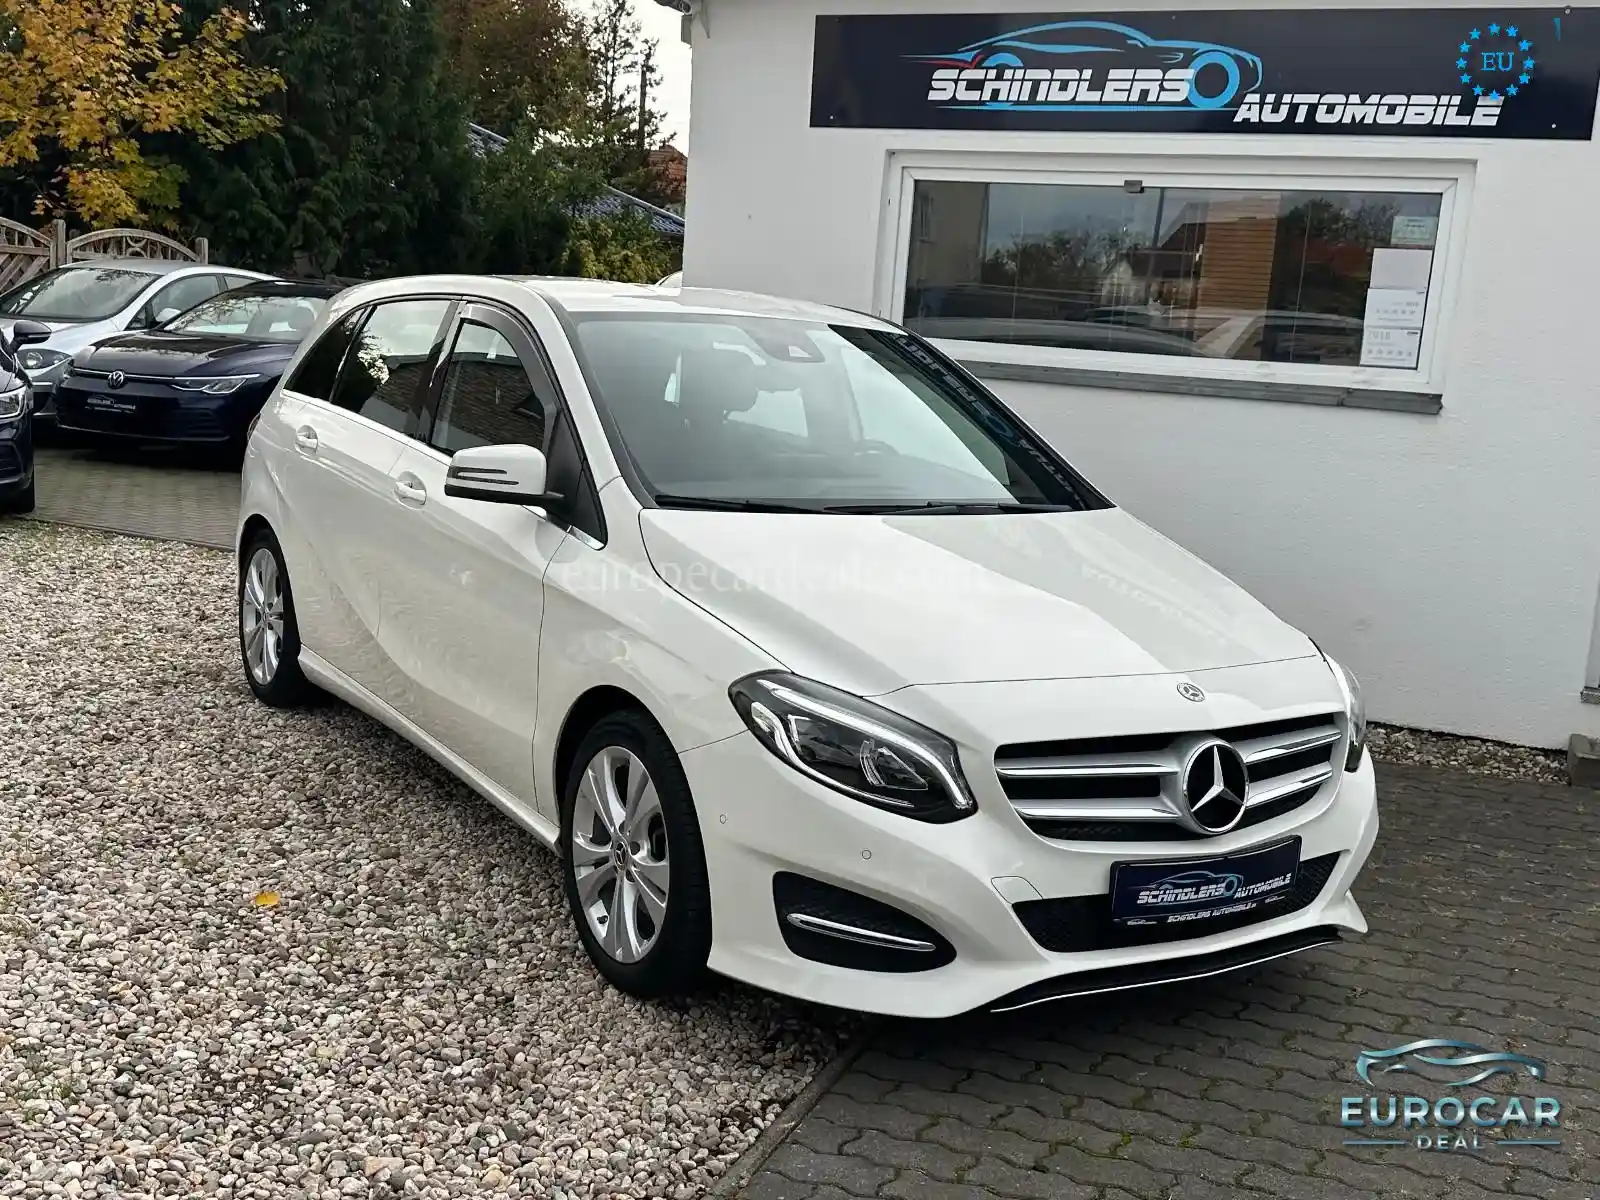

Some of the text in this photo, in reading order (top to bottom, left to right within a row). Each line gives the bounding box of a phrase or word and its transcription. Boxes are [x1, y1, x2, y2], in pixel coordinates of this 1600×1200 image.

[927, 68, 1505, 127] SCHINDLERS AUTOMOBILE
[1136, 873, 1292, 904] SCHINDLERS AUTOMOBILE
